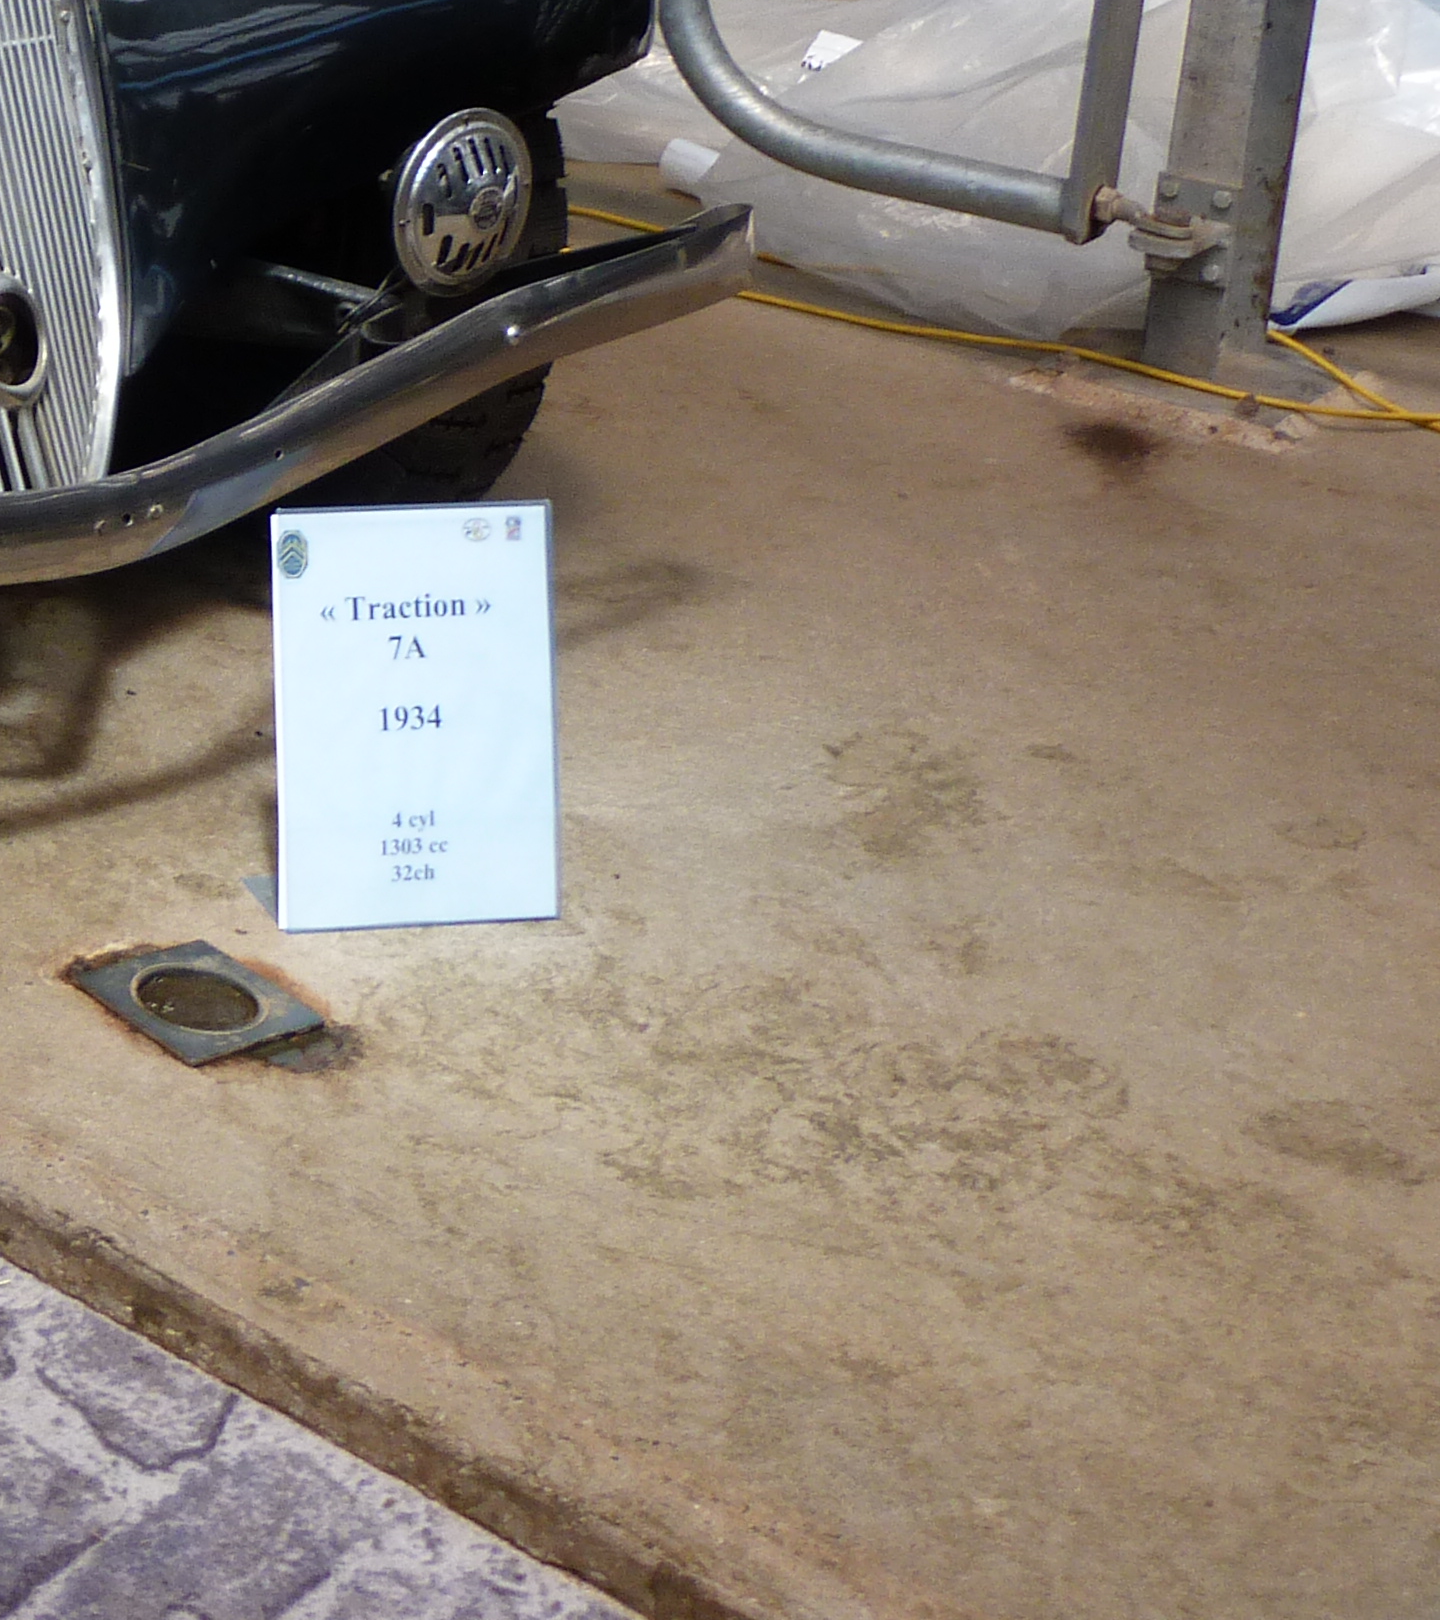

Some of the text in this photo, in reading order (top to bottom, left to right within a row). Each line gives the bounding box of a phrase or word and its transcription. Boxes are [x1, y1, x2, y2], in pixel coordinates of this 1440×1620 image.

[344, 592, 466, 622] Traction
[388, 635, 427, 660] 7A
[379, 703, 442, 732] 1934
[392, 810, 435, 833] 4 cyl
[381, 837, 448, 856] 1303 cc
[391, 863, 435, 883] 32ch
